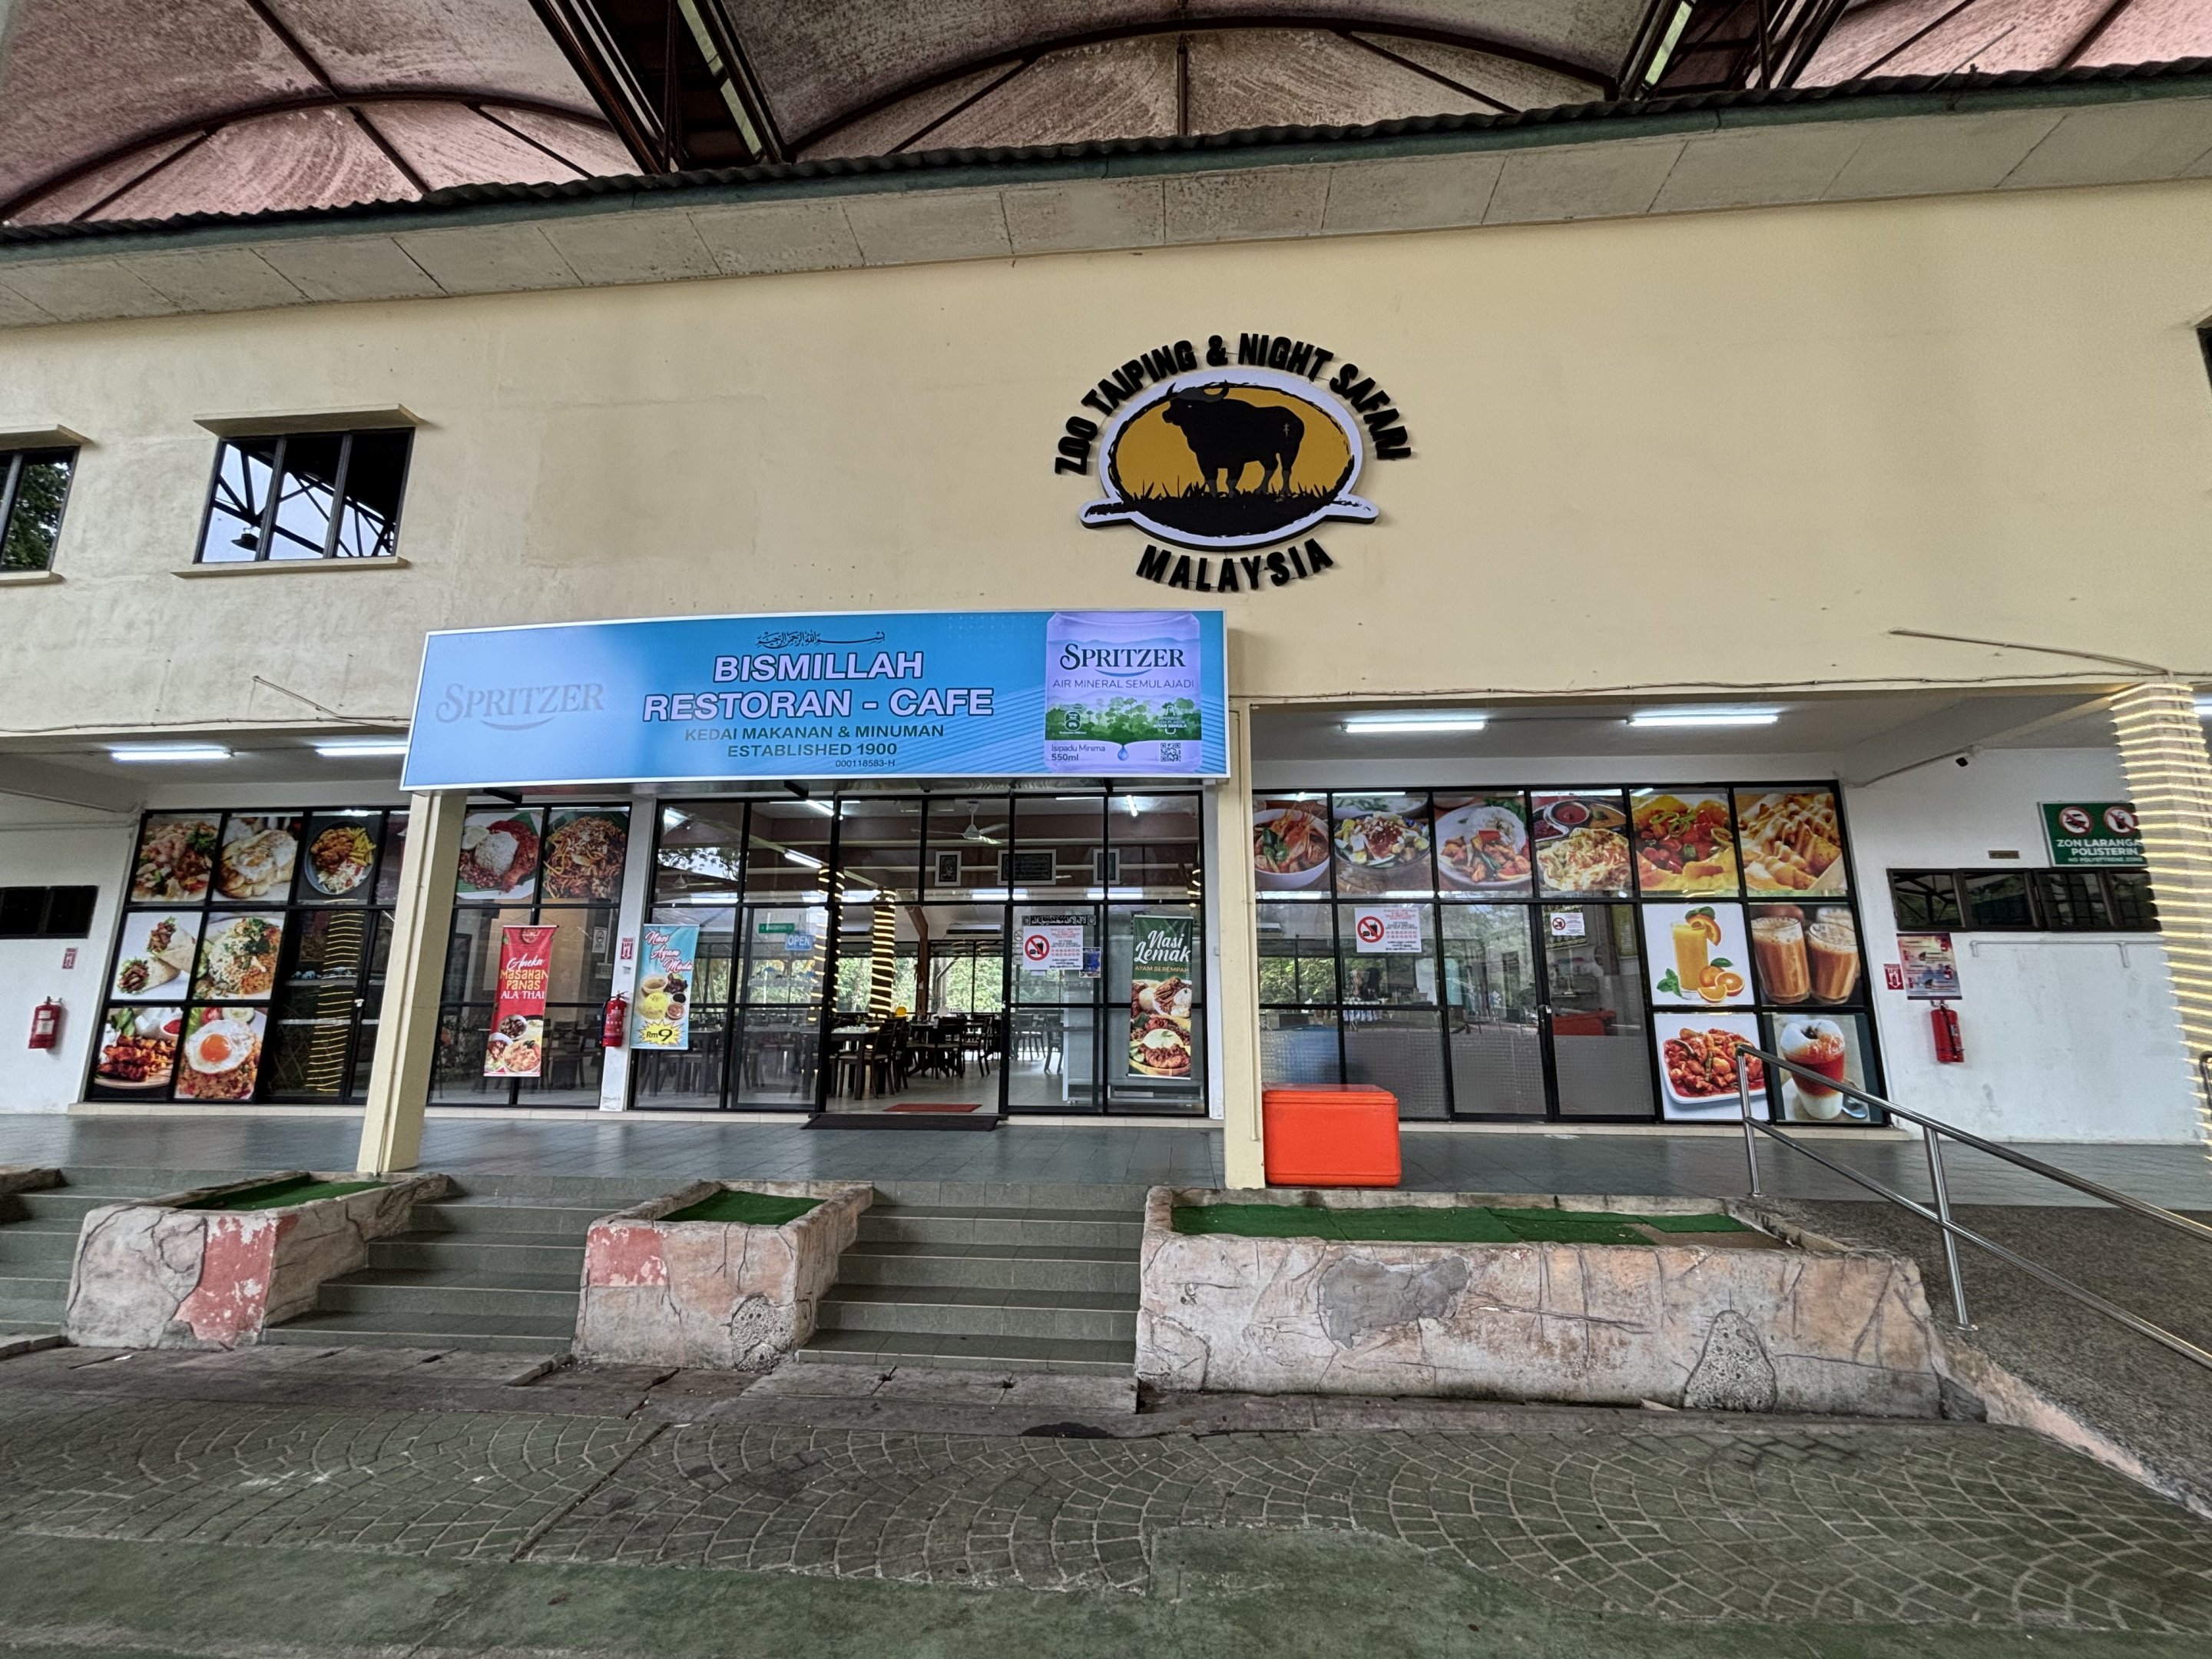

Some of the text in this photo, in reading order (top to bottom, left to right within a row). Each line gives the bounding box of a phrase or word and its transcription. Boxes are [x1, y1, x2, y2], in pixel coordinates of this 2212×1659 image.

[1055, 333, 1411, 475] ZOO TAIPING & NIGHT SAFARI
[1136, 538, 1333, 592] MALAYSIA
[1060, 644, 1186, 671] SPRITZER
[713, 651, 923, 683] BISMILLAH
[1053, 680, 1194, 688] AIR MINERAL SEMULAJADI
[643, 687, 994, 722] RESTORAN - CAFE
[685, 725, 944, 741] KEDAI MAKANAN & MINUMAN
[727, 743, 897, 757] ESTABLISHED 1900
[1051, 743, 1105, 754] Isipadu Minima
[2056, 839, 2144, 847] ZON LARANGA
[787, 935, 810, 946] OPEN
[1147, 930, 1184, 949] Nasi
[506, 953, 543, 971] Aneka
[651, 944, 680, 962] Ayam
[1134, 942, 1191, 964] Lemak
[501, 991, 545, 999] ALA THAI
